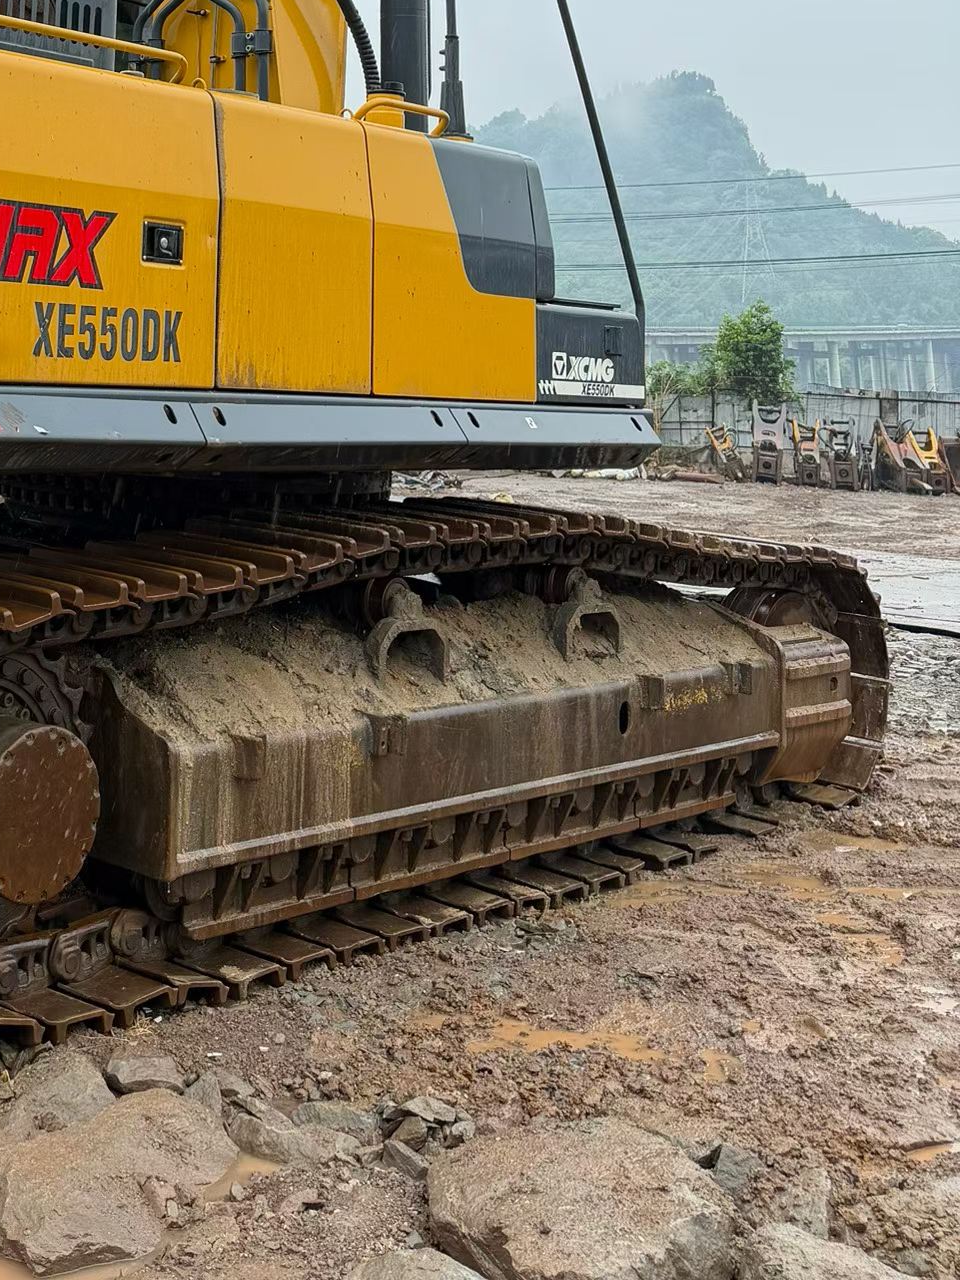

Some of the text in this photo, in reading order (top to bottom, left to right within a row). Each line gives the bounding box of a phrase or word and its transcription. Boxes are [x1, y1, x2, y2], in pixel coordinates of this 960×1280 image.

[32, 301, 183, 363] XE550DK
[566, 356, 615, 382] XCMG
[581, 383, 615, 397] XE550DK
